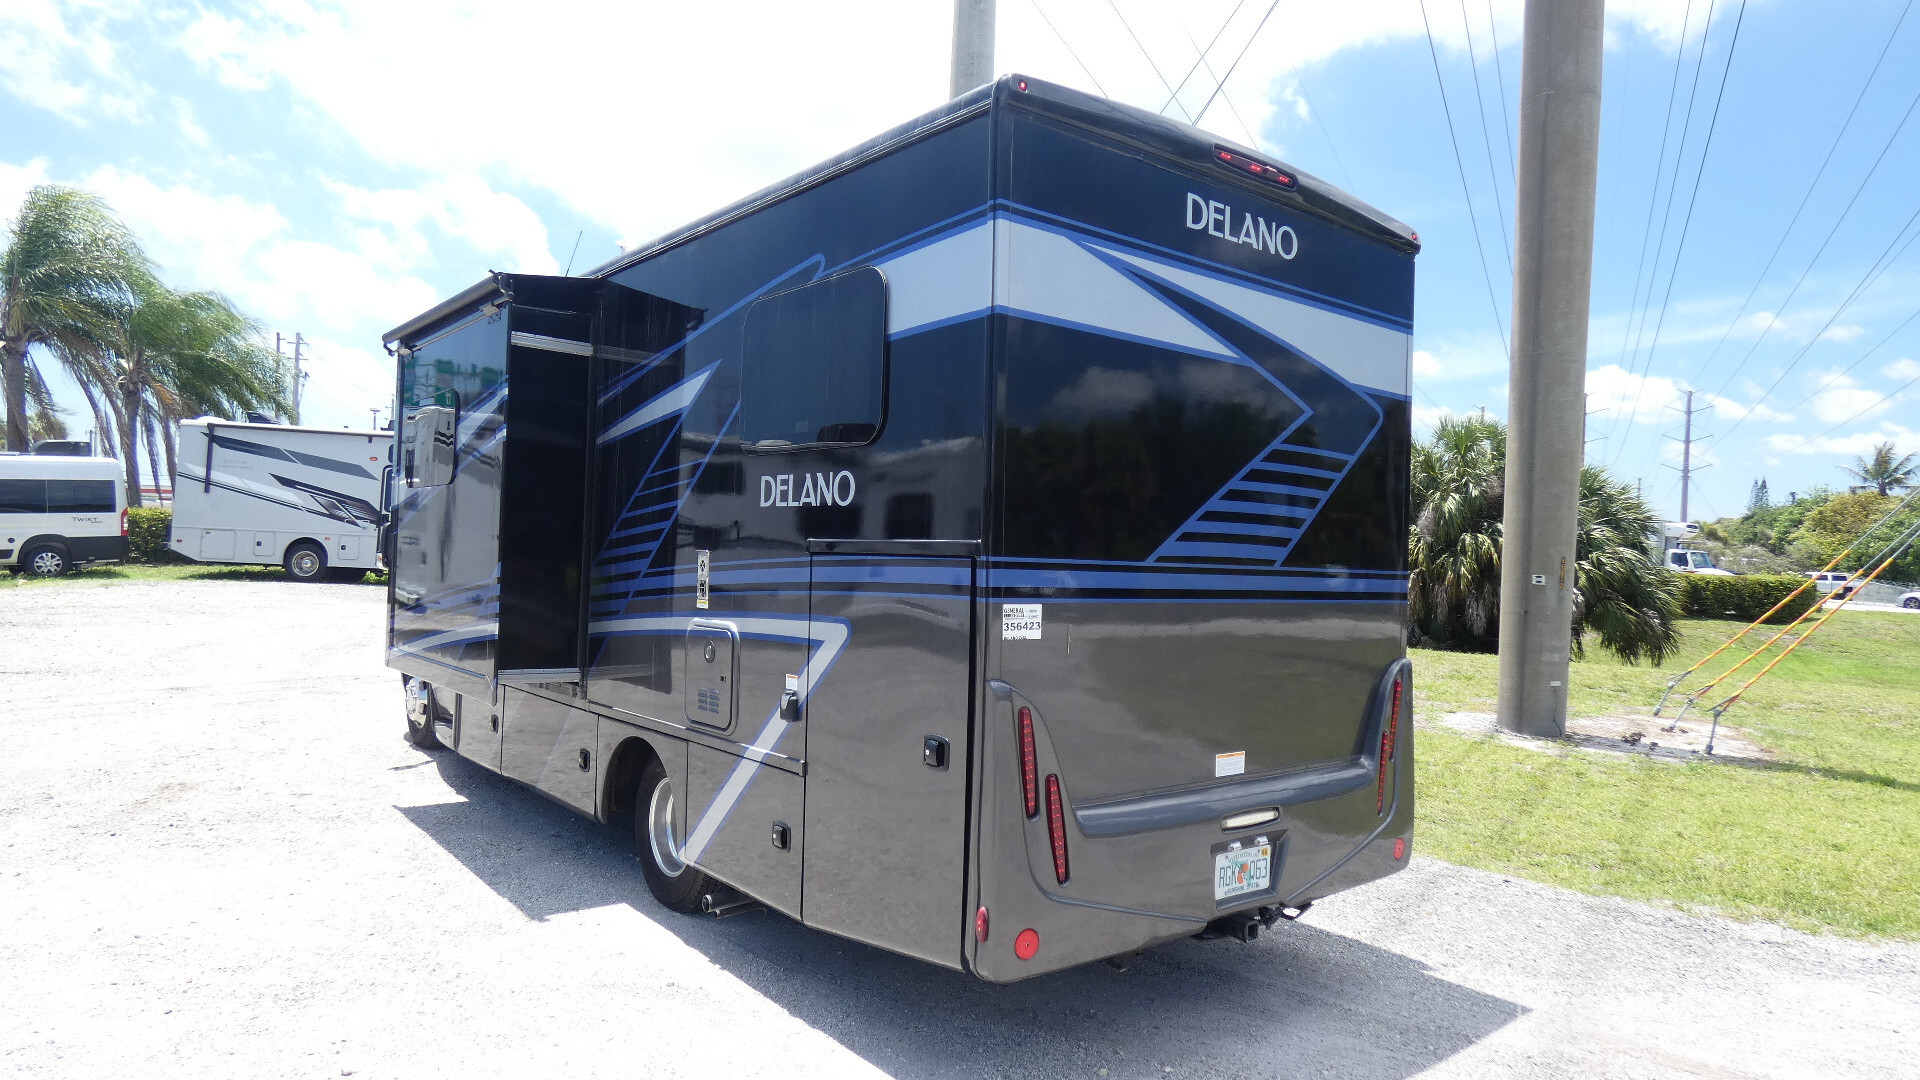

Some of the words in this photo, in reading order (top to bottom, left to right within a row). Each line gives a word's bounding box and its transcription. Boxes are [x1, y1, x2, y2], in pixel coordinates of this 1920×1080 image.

[1186, 192, 1298, 260] DELANO
[760, 470, 856, 507] DELANO
[1003, 621, 1041, 631] 356423
